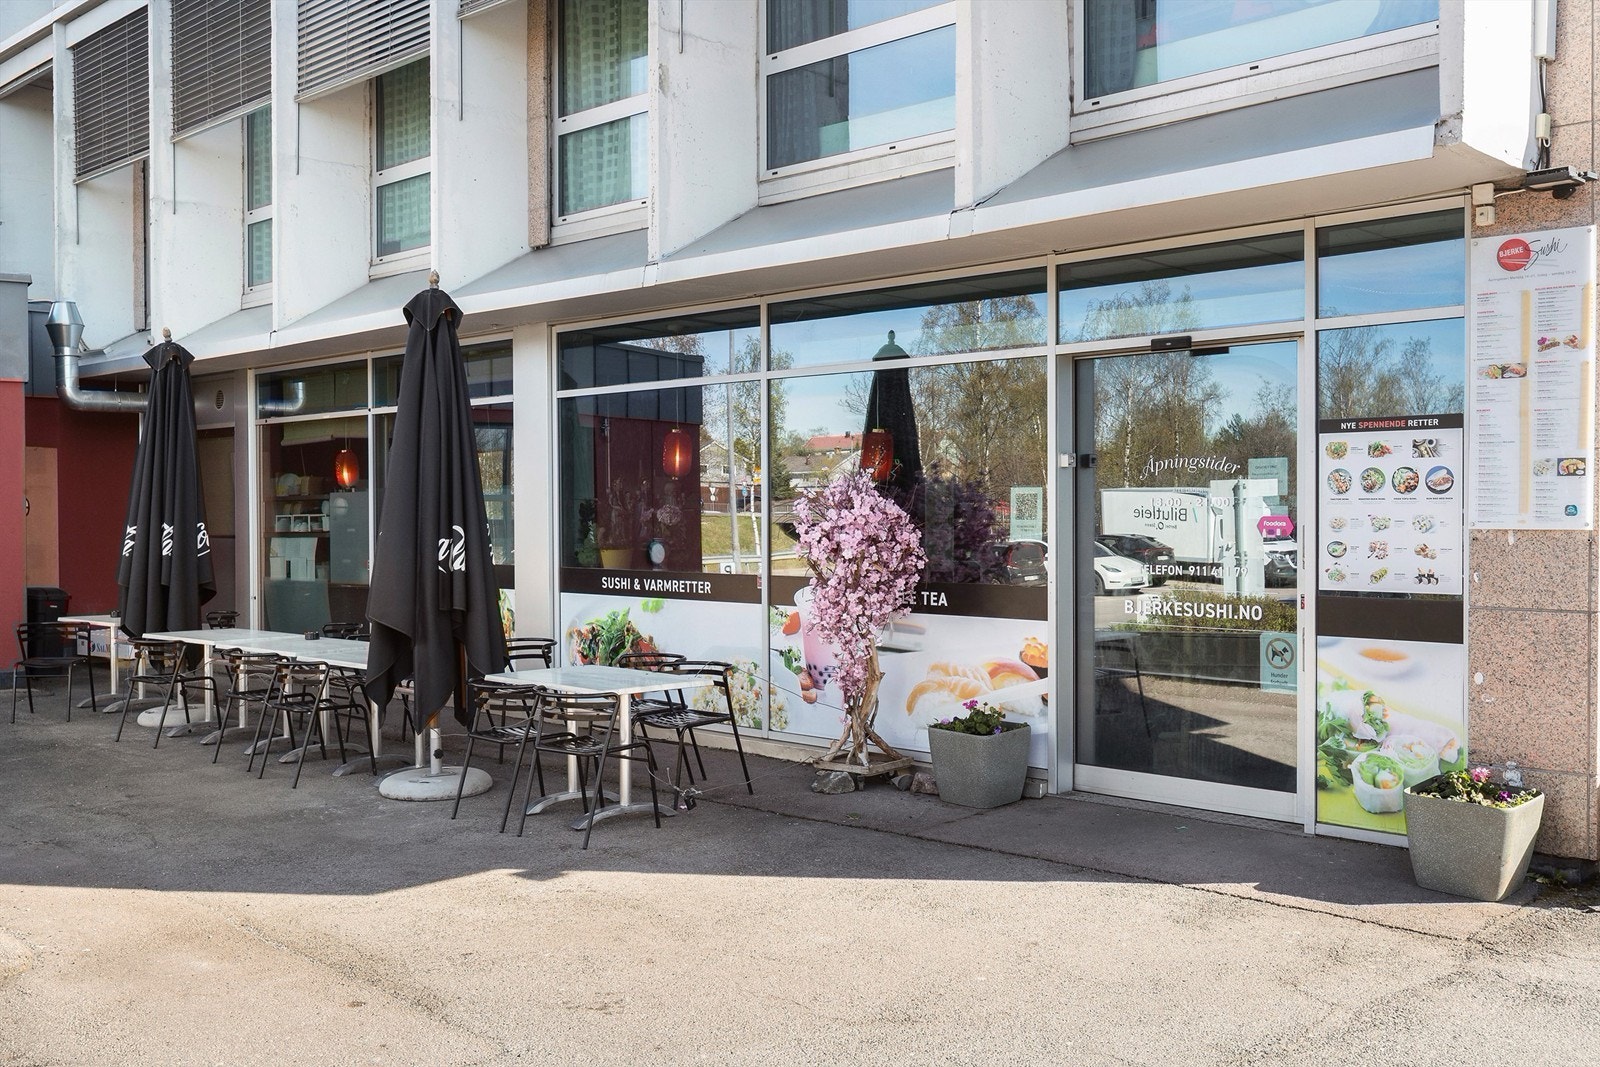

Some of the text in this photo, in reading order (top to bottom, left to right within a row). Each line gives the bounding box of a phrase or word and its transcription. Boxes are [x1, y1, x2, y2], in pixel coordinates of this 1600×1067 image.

[1499, 237, 1568, 271] BJERKE Sushi
[1340, 418, 1439, 430] NYE SPENNENDE RETTER
[1140, 455, 1241, 480] Åpningstider
[601, 576, 712, 594] SUSHI & VARMRETTER
[921, 591, 948, 607] TEA
[1124, 600, 1263, 621] BJERKESUSHI.NO
